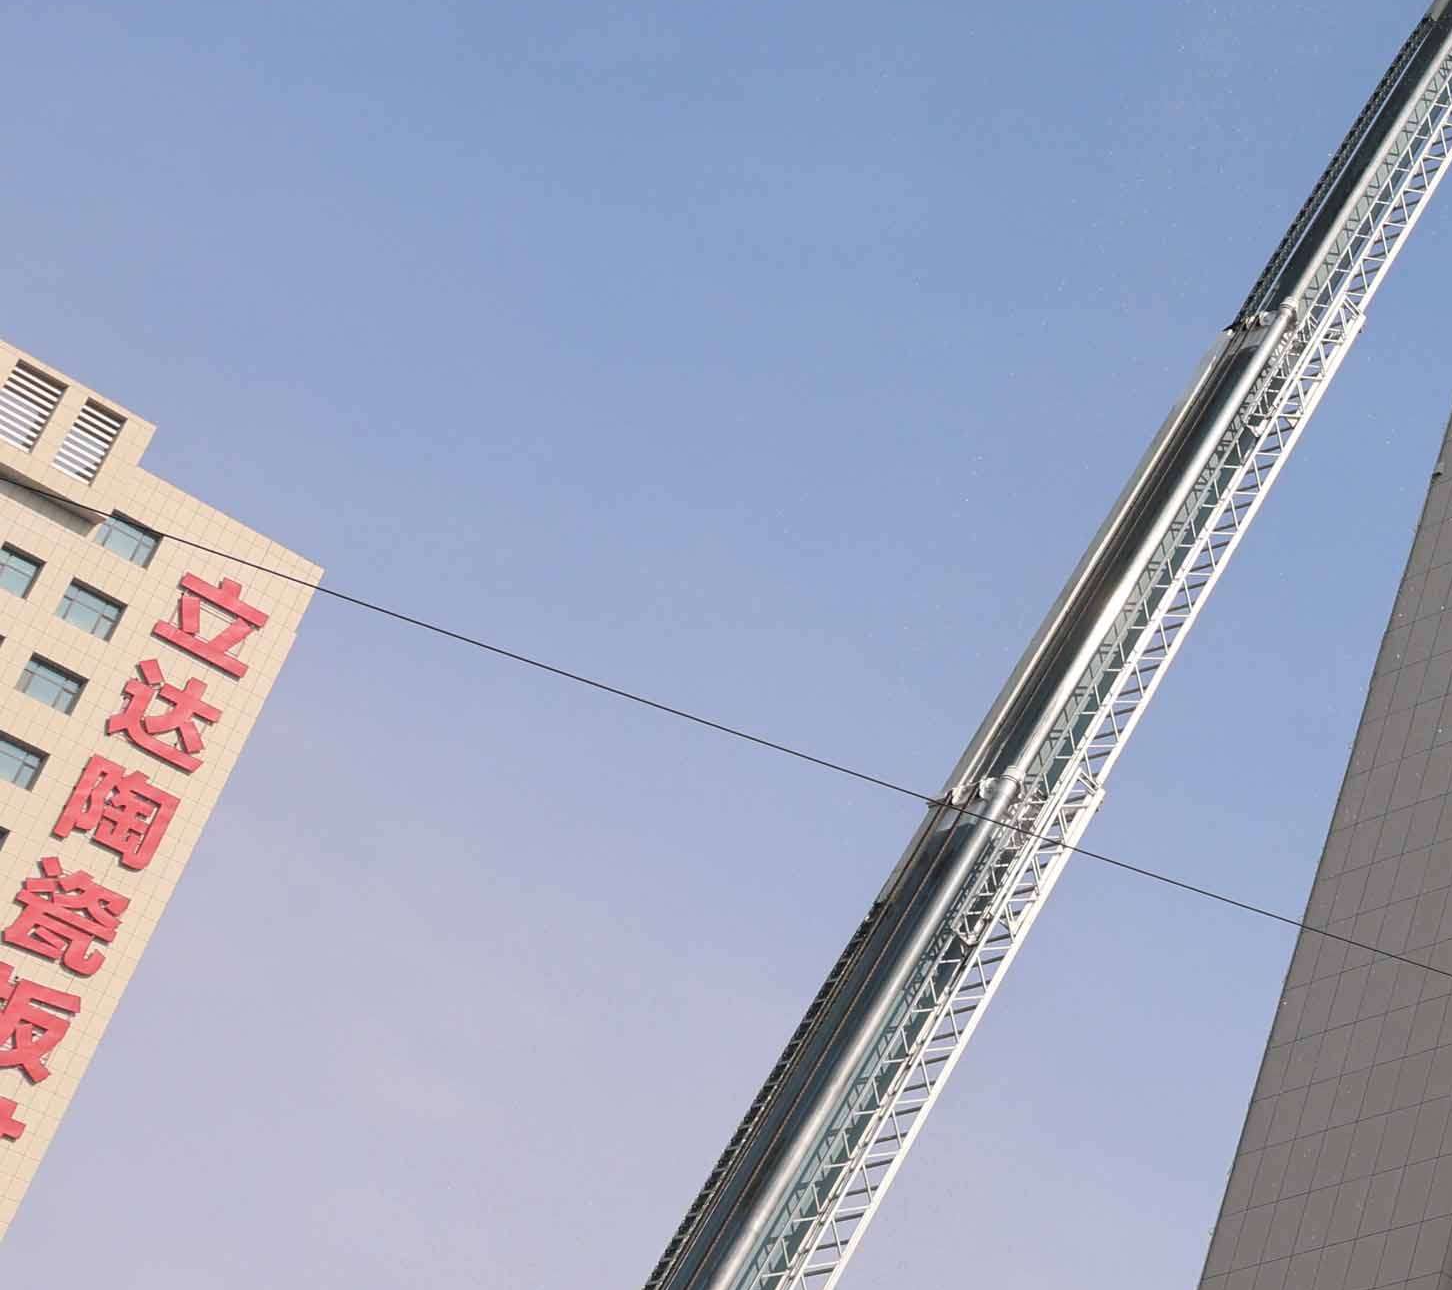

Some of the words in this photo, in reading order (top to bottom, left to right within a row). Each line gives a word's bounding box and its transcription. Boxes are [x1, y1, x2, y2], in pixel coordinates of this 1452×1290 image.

[0, 569, 270, 1141] 立达陶瓷板
